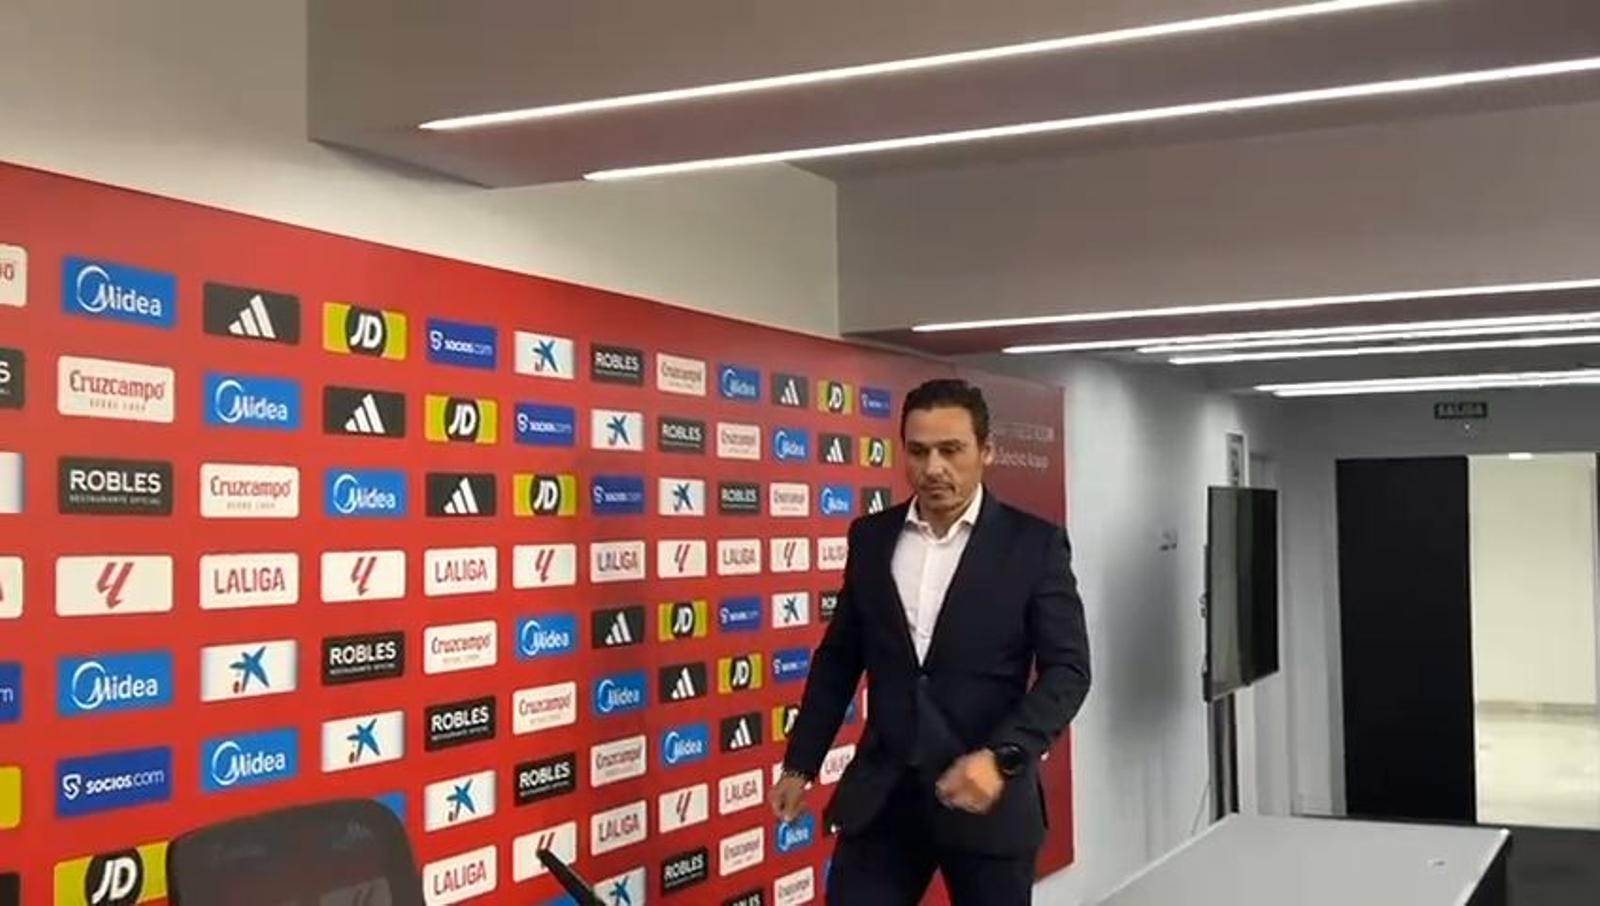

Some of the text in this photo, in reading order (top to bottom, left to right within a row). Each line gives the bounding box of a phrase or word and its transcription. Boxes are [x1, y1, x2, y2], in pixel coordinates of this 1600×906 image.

[77, 265, 162, 317] Midea
[350, 313, 383, 348] JD
[595, 352, 639, 371] ROBLES
[69, 369, 165, 400] Cruzcampo
[215, 379, 288, 423] Midea
[448, 404, 477, 435] JD
[662, 423, 702, 441] ROBLES
[70, 469, 162, 493] ROBLES
[210, 475, 292, 499] Cruzcampo
[333, 473, 396, 514] Midea
[533, 480, 557, 511] JD
[597, 551, 639, 572] LALIGA
[723, 548, 755, 565] LALIGA
[214, 567, 285, 594] LALIGA
[435, 560, 487, 583] LALIGA
[431, 632, 491, 655] Cruzcampo
[522, 620, 569, 656] Midea
[329, 641, 397, 665] ROBLES
[72, 661, 158, 709] Midea
[599, 679, 640, 712] Midea
[431, 706, 489, 732] ROBLES
[519, 694, 571, 716] Cruzcampo
[664, 731, 702, 763] Midea
[212, 741, 286, 785] Midea
[519, 762, 570, 788] ROBLES
[86, 767, 165, 795] socios.com
[725, 779, 757, 804] LALIGA
[599, 813, 640, 842] LALIGA
[92, 855, 138, 904] JD
[434, 859, 487, 895] LALIGA
[664, 854, 703, 881] ROBLES
